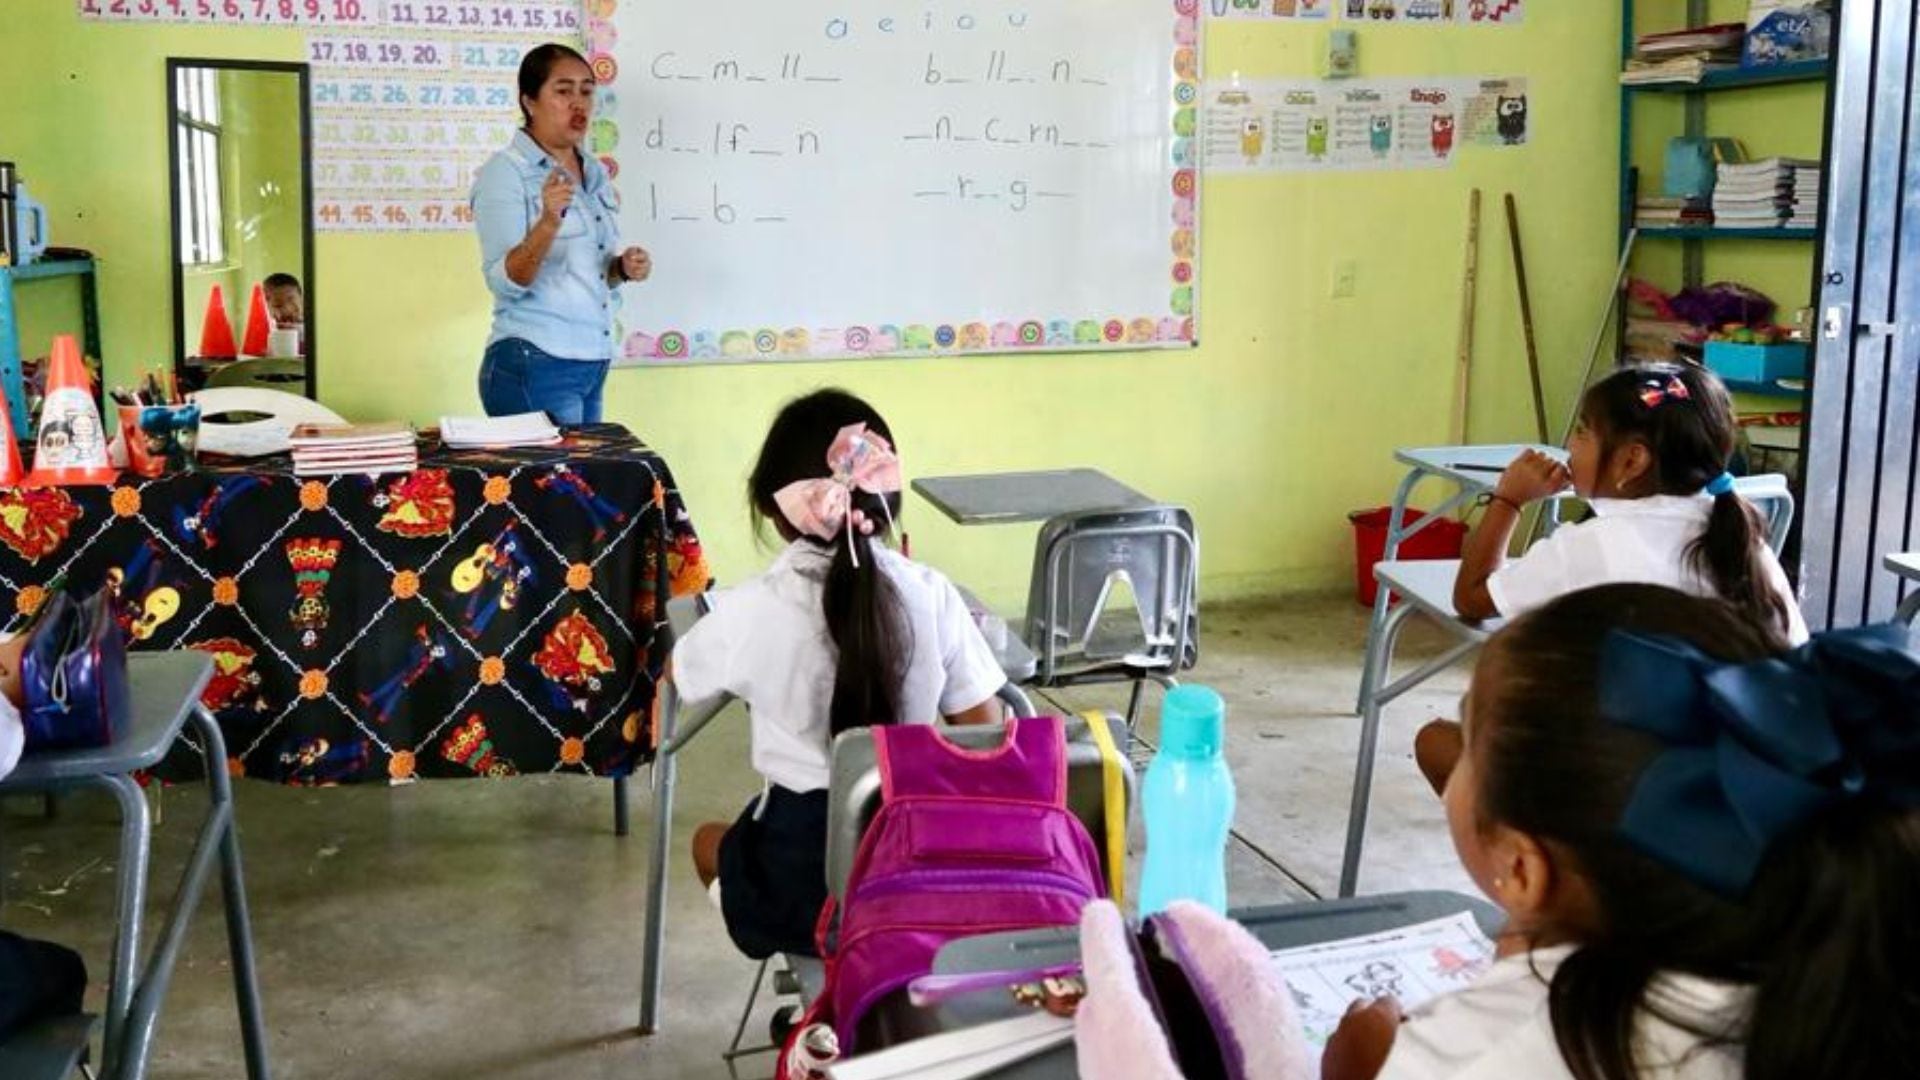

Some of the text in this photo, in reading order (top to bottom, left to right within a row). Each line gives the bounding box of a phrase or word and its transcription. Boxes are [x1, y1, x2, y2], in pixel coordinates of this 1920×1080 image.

[825, 11, 1027, 40] a e i o u
